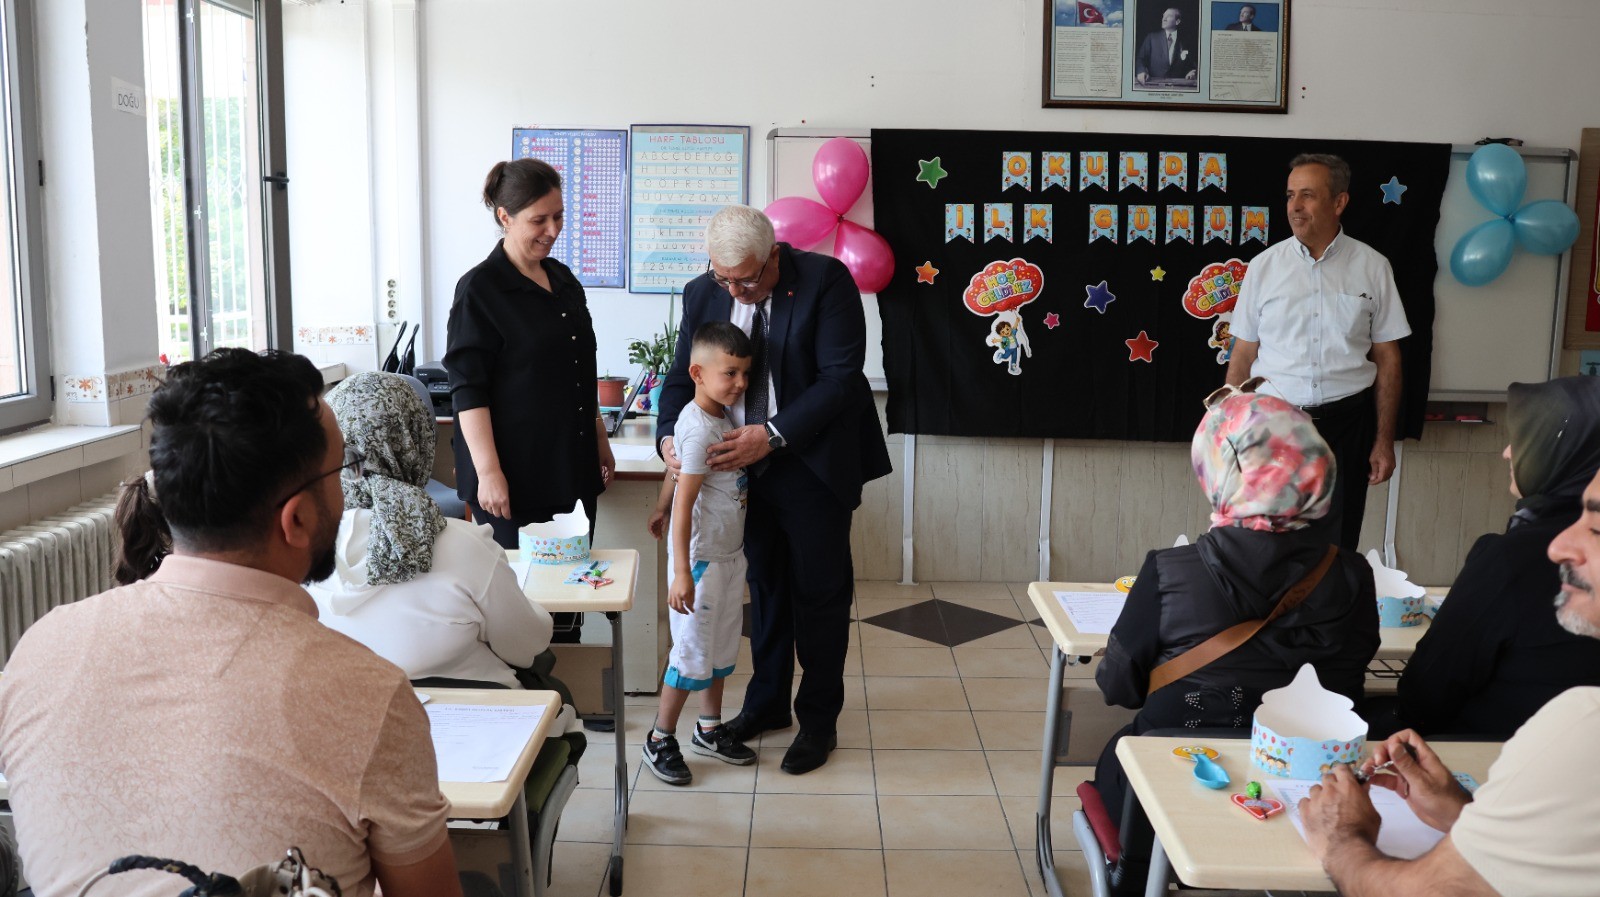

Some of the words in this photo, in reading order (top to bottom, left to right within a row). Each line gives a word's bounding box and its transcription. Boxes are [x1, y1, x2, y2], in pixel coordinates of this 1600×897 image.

[118, 93, 140, 109] DOĞU
[680, 136, 725, 144] TABLOSU
[1008, 155, 1222, 177] OKULDA
[955, 205, 1046, 230] İLK
[1095, 207, 1265, 231] GÜNÜM
[984, 270, 1017, 290] HOŞ
[1202, 271, 1234, 293] HOŞ
[977, 280, 1034, 307] GELDİNİZ
